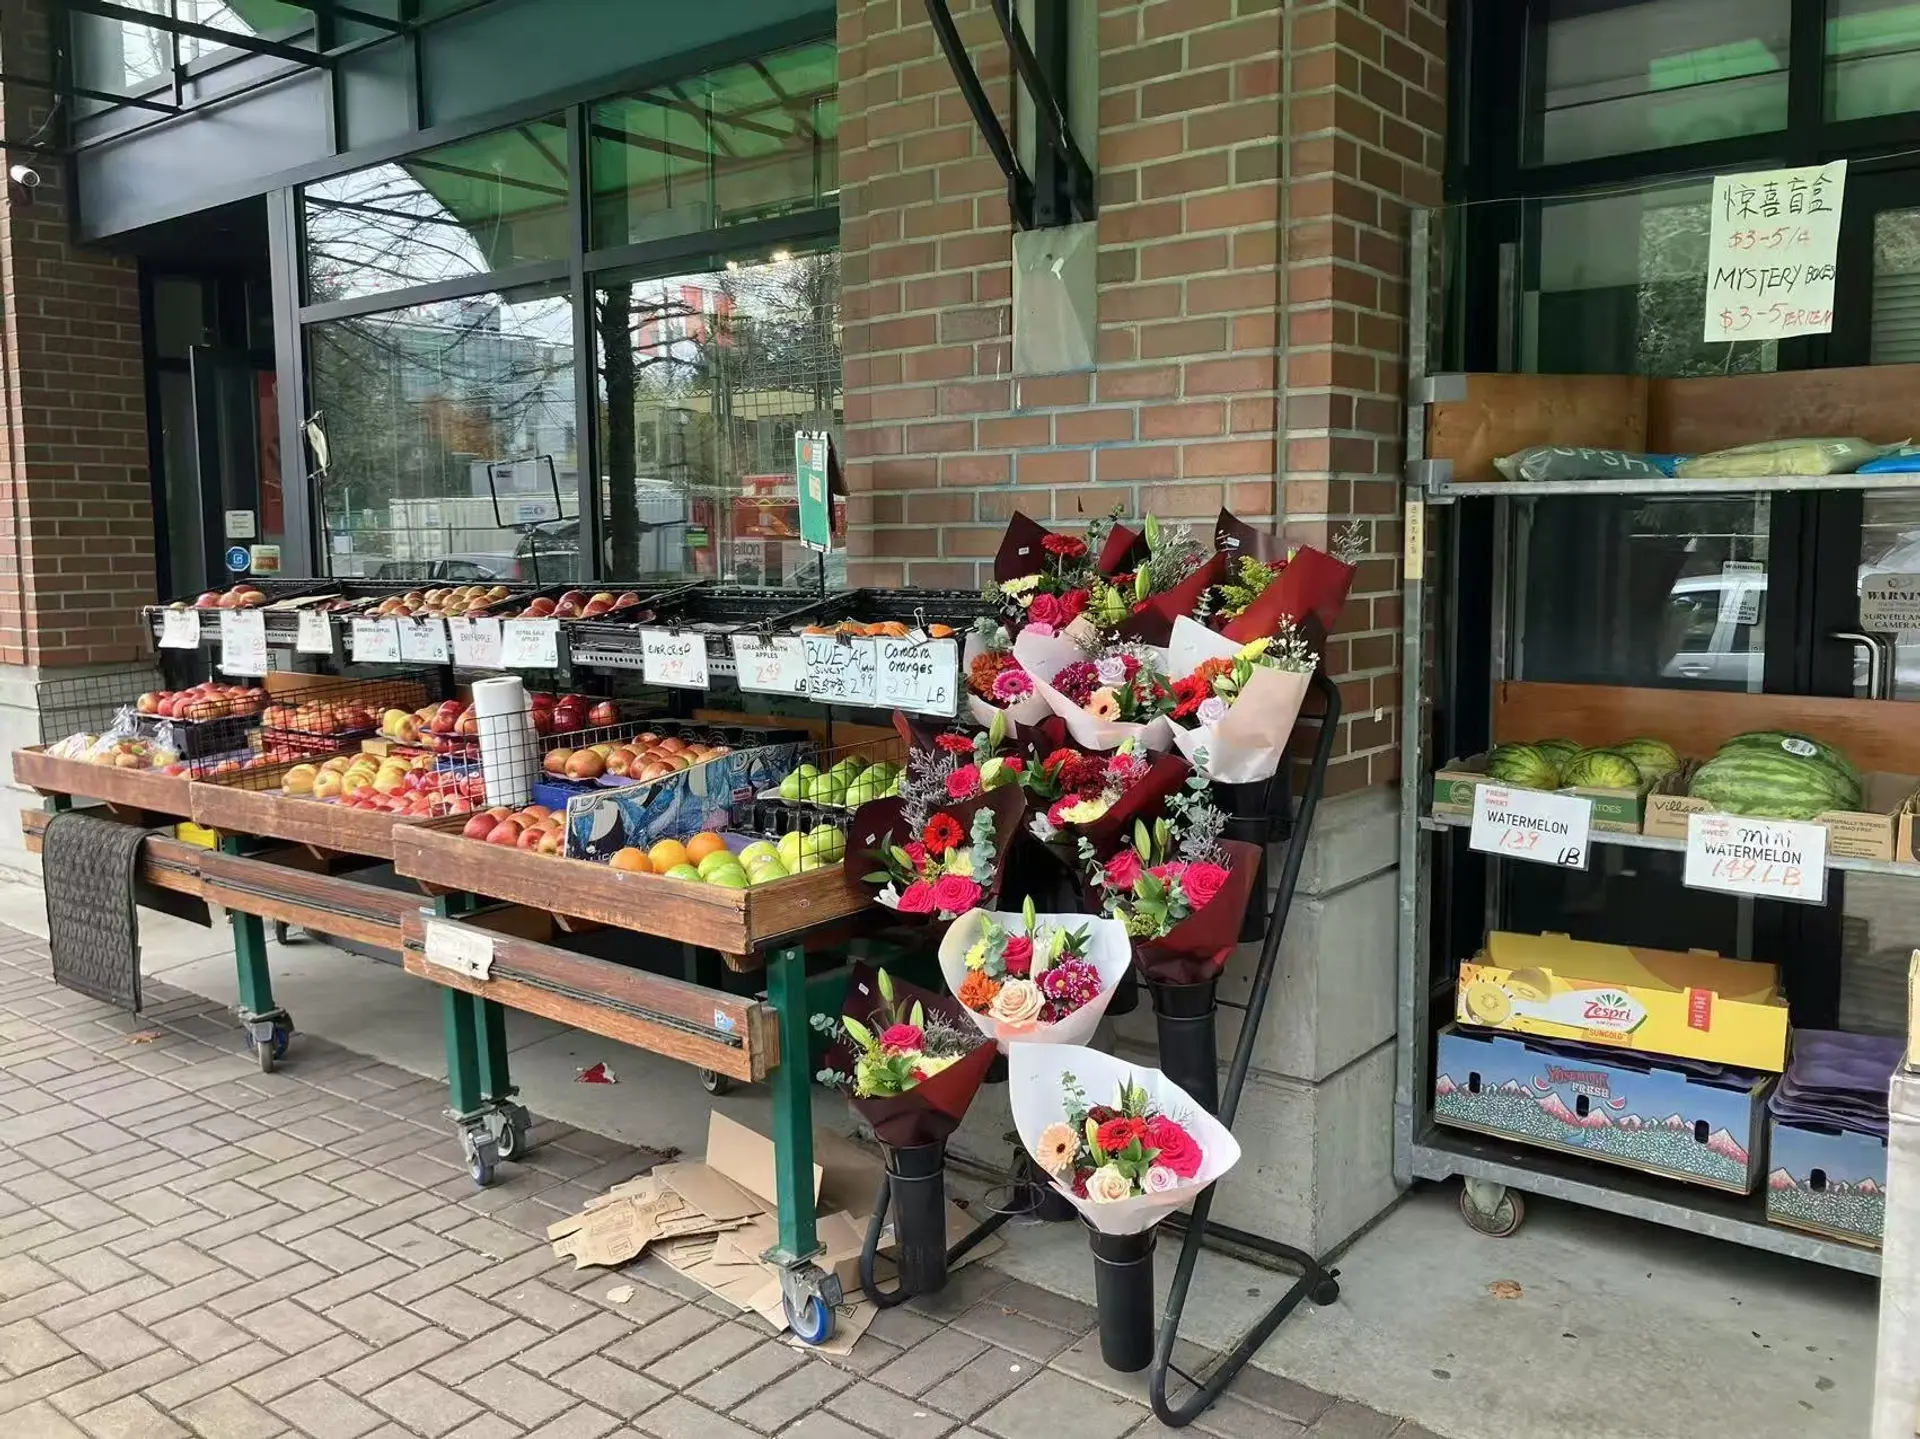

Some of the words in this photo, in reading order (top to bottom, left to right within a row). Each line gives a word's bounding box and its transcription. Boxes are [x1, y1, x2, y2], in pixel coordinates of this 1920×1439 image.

[1723, 173, 1832, 221] 惊喜盲盒
[1714, 264, 1801, 296] MYSTERY
[806, 641, 843, 666] BLUE
[795, 678, 806, 692] LB
[927, 687, 946, 703] LB
[1594, 804, 1622, 813] ATOES
[1487, 810, 1568, 835] WATERMELON
[1737, 826, 1794, 848] mini
[1557, 847, 1581, 865] LB
[1705, 842, 1801, 864] WATERMELON
[1583, 1000, 1632, 1020] Zespri
[1571, 1081, 1609, 1098] FRESH
